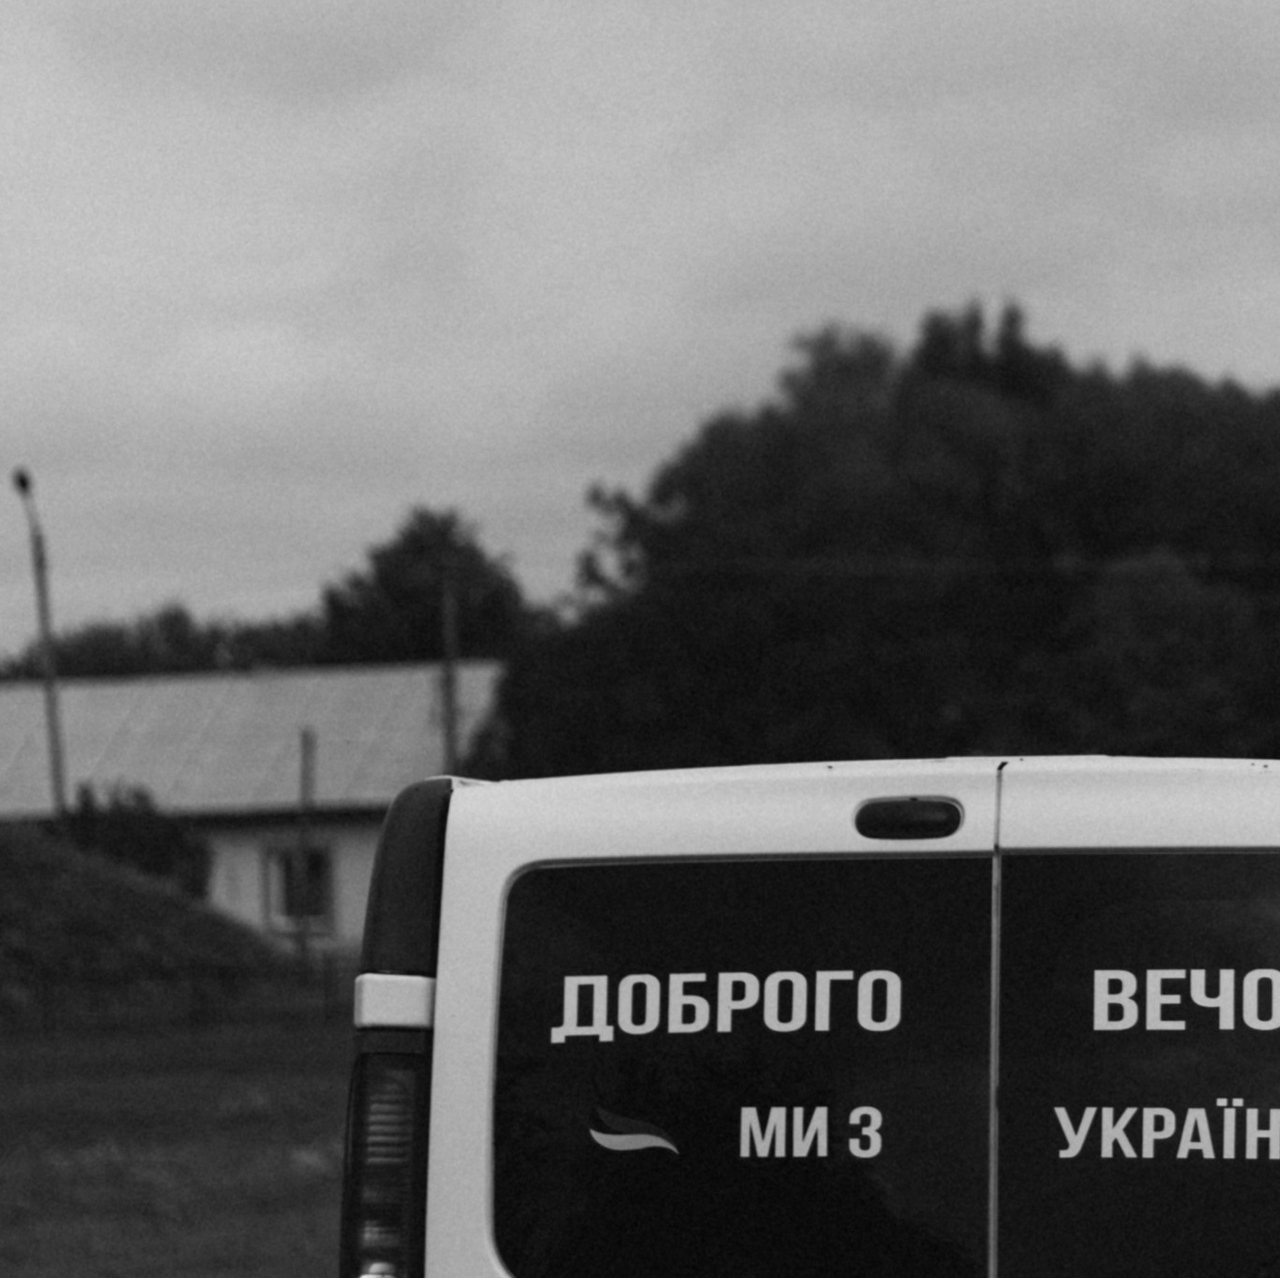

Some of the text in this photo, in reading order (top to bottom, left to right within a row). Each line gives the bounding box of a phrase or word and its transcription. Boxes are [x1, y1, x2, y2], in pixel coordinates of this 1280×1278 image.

[550, 969, 902, 1044] ДОБРОГО
[739, 1106, 829, 1158] МИ
[848, 1105, 883, 1159] З
